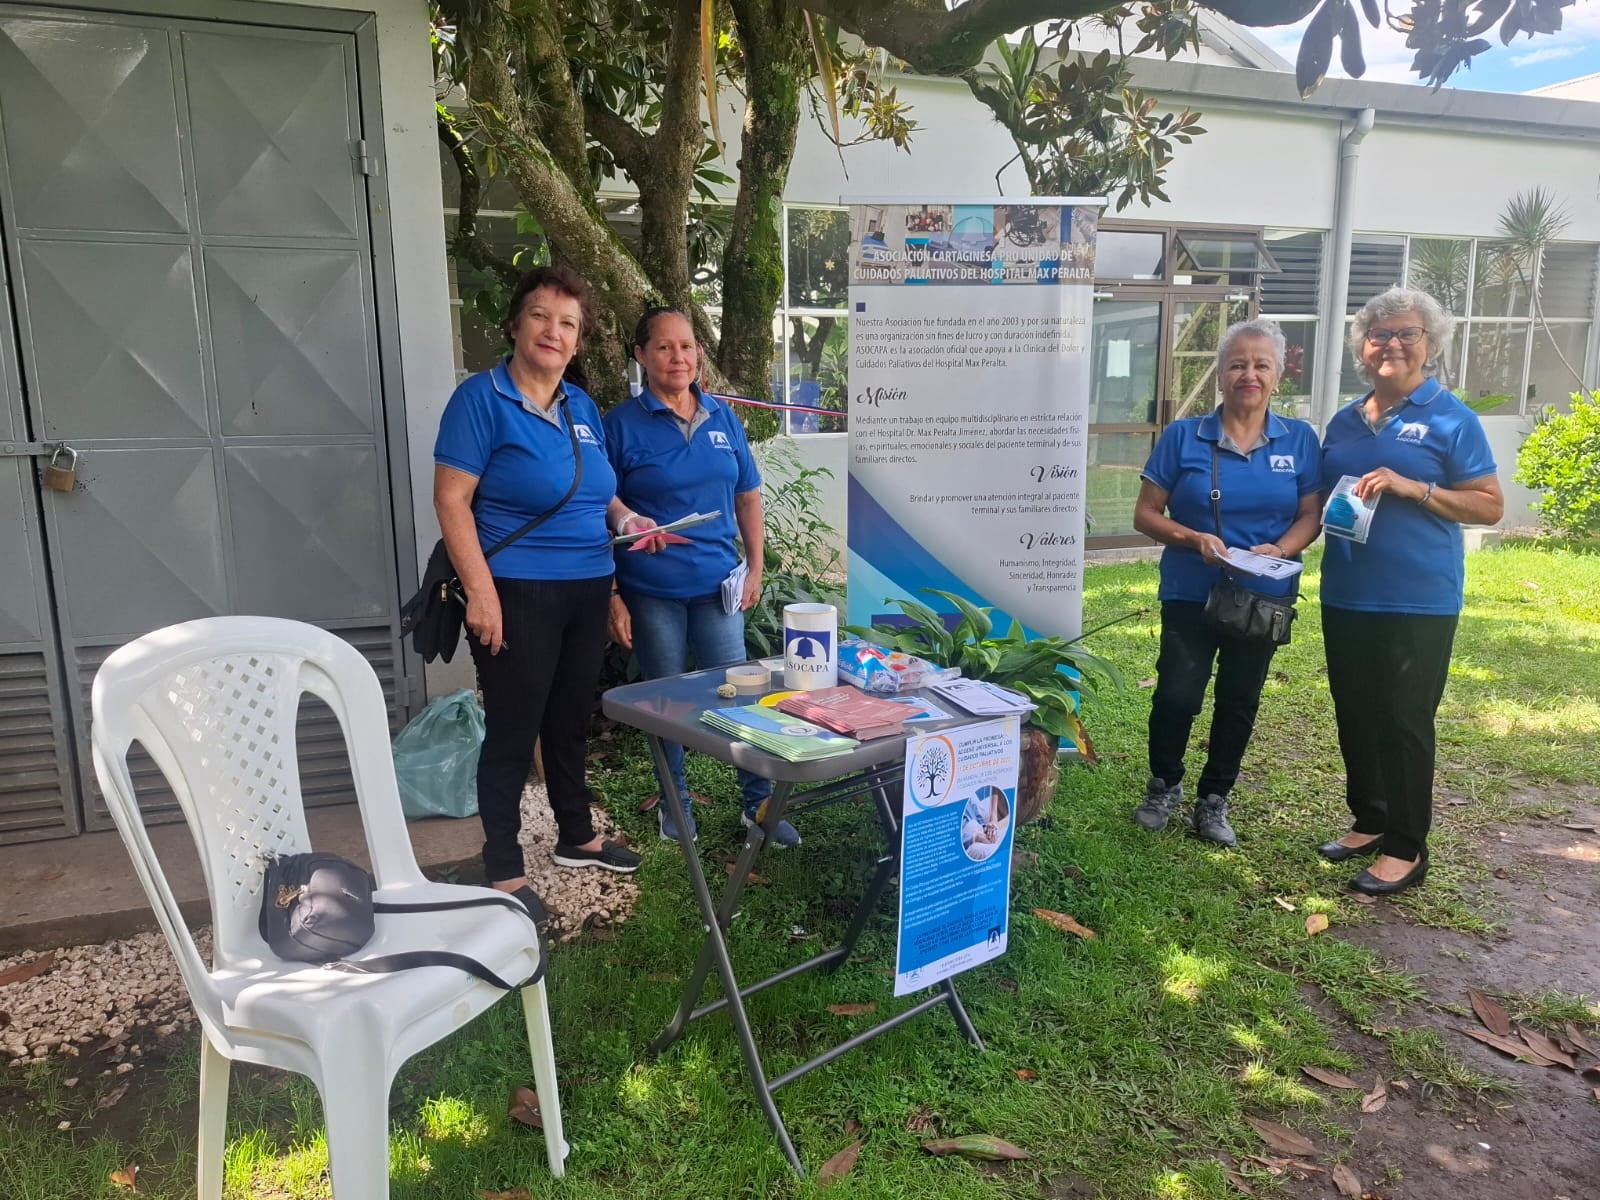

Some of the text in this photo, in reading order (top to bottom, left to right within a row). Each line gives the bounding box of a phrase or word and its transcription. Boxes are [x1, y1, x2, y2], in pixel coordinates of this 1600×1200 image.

[873, 248, 1073, 262] ASOCIACIÓN CARTAGINESA PRO UNIDAD DE
[853, 267, 1090, 280] CUIDADOS PALIATIVOS DEL HOSPITAL MAX PERALTA
[855, 317, 883, 327] Nuestra
[923, 317, 935, 327] fue
[937, 316, 966, 327] fundada
[978, 316, 985, 326] el
[1001, 316, 1019, 326] 2003
[1021, 318, 1026, 328] y
[1027, 318, 1039, 328] por
[855, 333, 864, 341] es
[865, 333, 879, 341] una
[925, 331, 936, 340] sin
[937, 331, 954, 340] fines
[955, 331, 964, 340] de
[965, 330, 983, 340] lucro
[984, 332, 988, 342] y
[989, 332, 1003, 340] con
[1003, 330, 1034, 340] duración
[855, 345, 888, 355] ASOCAPA
[889, 346, 898, 355] es
[899, 345, 907, 354] la
[908, 344, 945, 355] asociación
[946, 344, 967, 354] oficial
[969, 346, 983, 356] que
[984, 346, 1006, 356] apoya
[1014, 344, 1021, 353] la
[1048, 343, 1059, 353] del
[855, 358, 1008, 370] Cuidados Paliativos del Hospital Max Peralta.
[856, 386, 908, 408] Misión
[855, 415, 888, 425] Mediante
[889, 416, 899, 424] un
[899, 415, 924, 426] trabajo
[935, 416, 959, 426] equipo
[960, 413, 1019, 425] multidisciplinario
[1030, 412, 1056, 422] estricta
[855, 430, 868, 438] con
[869, 428, 876, 438] el
[877, 428, 905, 439] Hospital
[906, 428, 916, 437] Dr.
[918, 428, 932, 437] Max
[933, 427, 957, 437] Peralta
[989, 426, 1015, 436] abordar
[1016, 425, 1027, 435] las
[1028, 424, 1069, 435] necesidades
[910, 441, 952, 451] emocionales
[953, 441, 958, 451] y
[958, 440, 985, 450] sociales
[985, 440, 996, 449] del
[997, 440, 1026, 450] paciente
[1026, 439, 1056, 449] terminal
[1056, 440, 1061, 449] y
[1062, 439, 1070, 448] de
[1071, 440, 1082, 448] sus
[855, 455, 888, 464] familiares
[1030, 464, 1079, 483] Visión
[909, 493, 935, 503] Brindar
[935, 495, 940, 504] y
[940, 494, 972, 504] promover
[987, 492, 1017, 502] atención
[1017, 492, 1044, 502] integral
[1044, 491, 1051, 500] al
[1052, 491, 1080, 501] paciente
[971, 506, 1000, 515] terminal
[1001, 506, 1006, 515] y
[1006, 506, 1017, 514] sus
[1018, 504, 1051, 514] familiares
[1019, 531, 1076, 550] Valores
[999, 559, 1041, 569] Humanismo,
[1046, 570, 1077, 579] Honradez
[1027, 583, 1077, 593] y Transparencia
